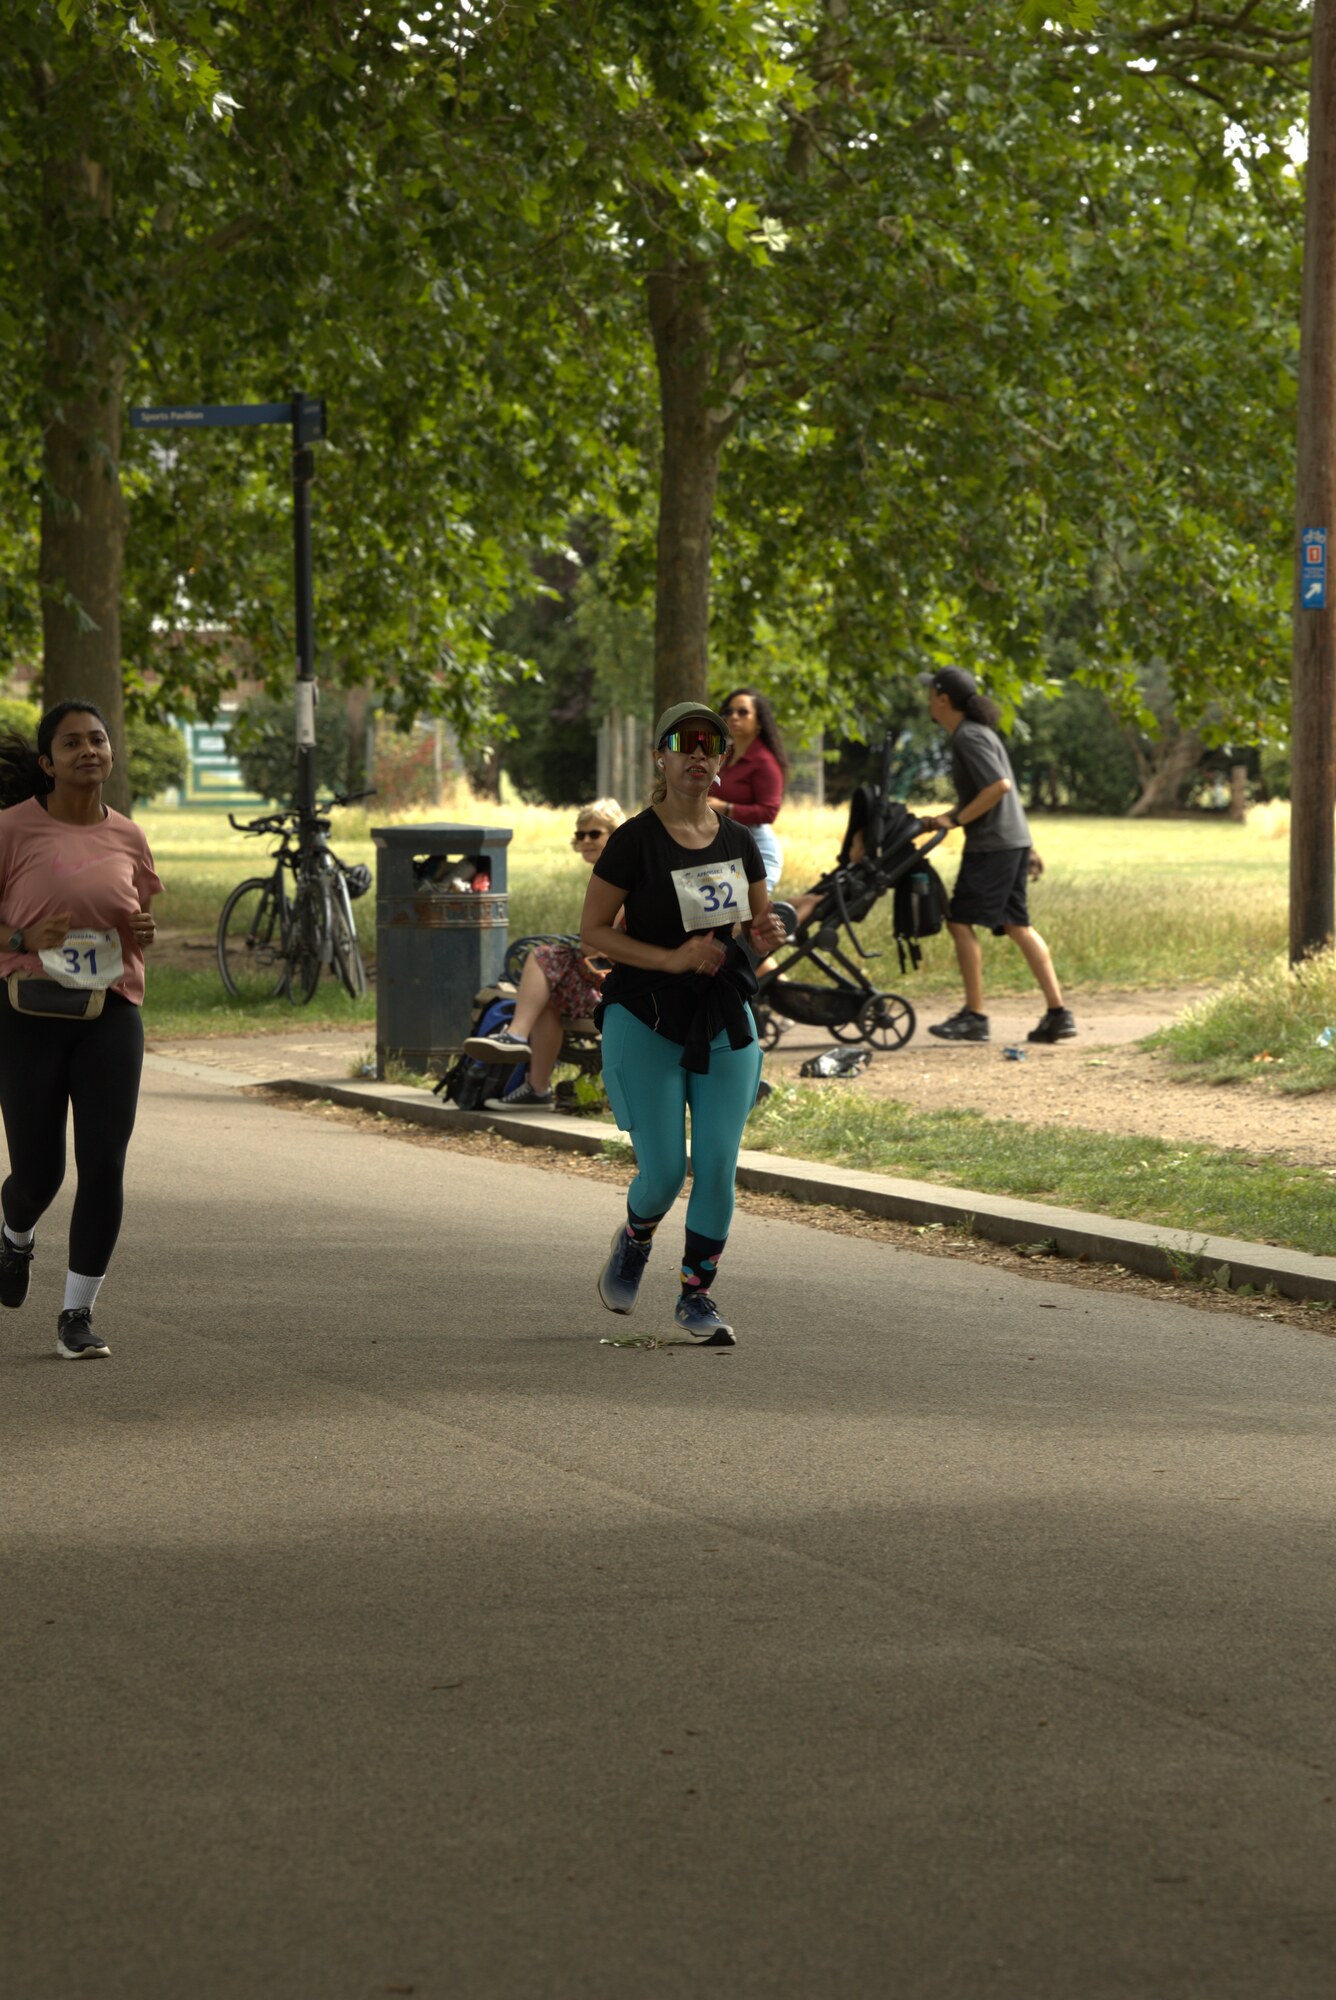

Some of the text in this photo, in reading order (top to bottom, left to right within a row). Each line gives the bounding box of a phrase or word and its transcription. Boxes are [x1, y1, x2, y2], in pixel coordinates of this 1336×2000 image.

[140, 411, 204, 423] Sports Pavilion
[699, 881, 737, 912] 32
[62, 948, 97, 976] 31
